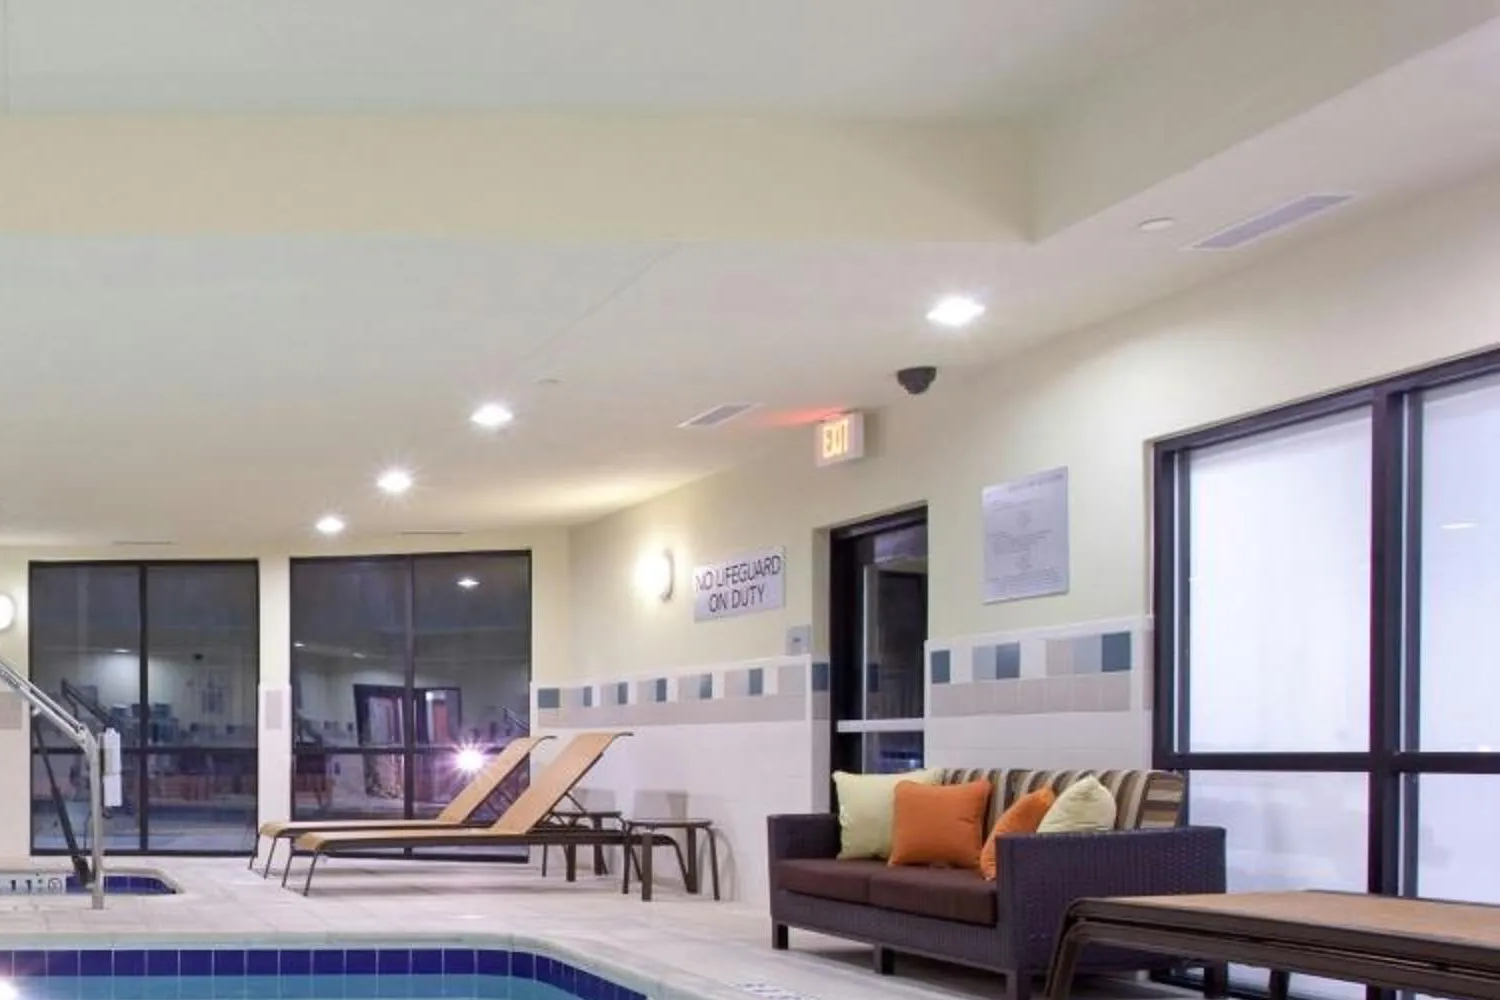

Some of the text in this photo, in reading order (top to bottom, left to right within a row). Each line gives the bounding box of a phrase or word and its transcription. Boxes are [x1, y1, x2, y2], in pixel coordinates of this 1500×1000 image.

[693, 555, 781, 592] NO LIFEGUARD
[708, 584, 765, 613] ON DUTY
